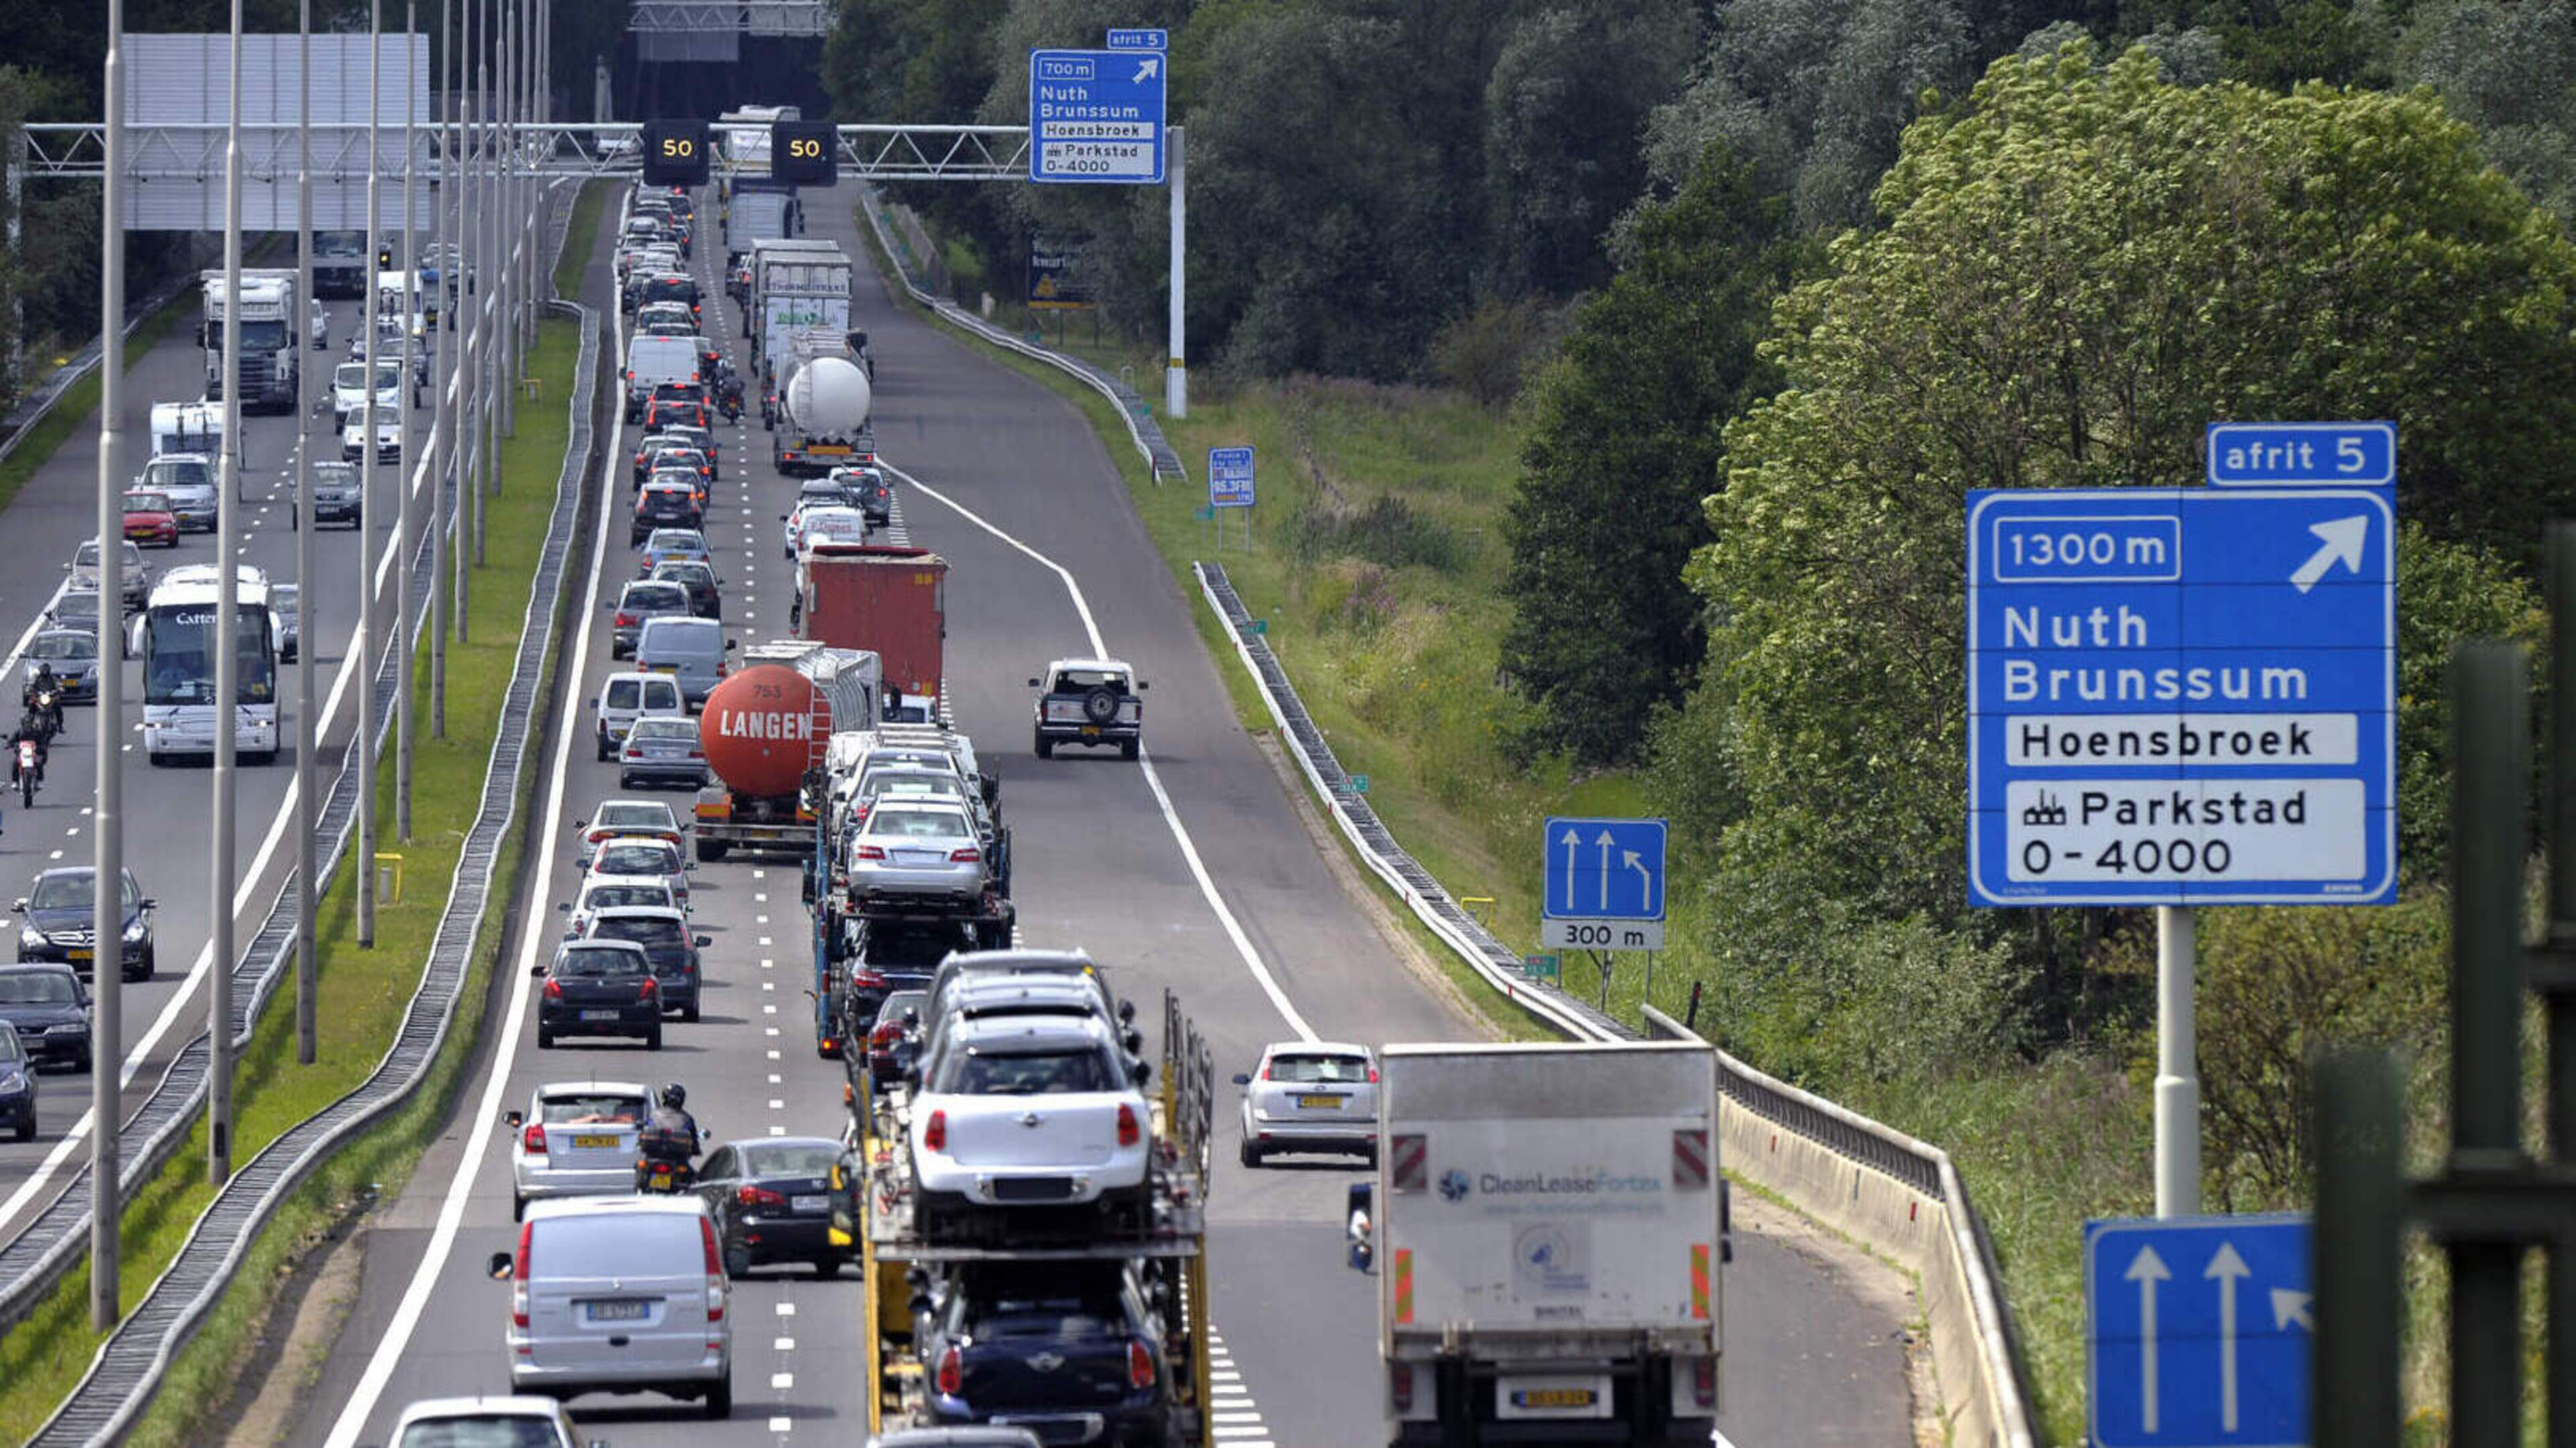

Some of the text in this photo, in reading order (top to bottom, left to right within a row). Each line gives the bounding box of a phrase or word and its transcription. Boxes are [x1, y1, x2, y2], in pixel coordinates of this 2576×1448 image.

[1112, 33, 1158, 46] afrit 5
[1044, 63, 1089, 74] 700 m
[1041, 85, 1087, 101] Nuth
[1041, 103, 1138, 118] Brunssum
[1046, 124, 1140, 136] Hoensbroek
[663, 139, 692, 156] 50
[790, 140, 820, 157] 50
[1065, 144, 1138, 157] Parkstad
[2226, 437, 2365, 471] afrit 5
[2010, 533, 2165, 565] 1300 m
[2004, 604, 2147, 649] Nuth
[2004, 659, 2307, 701] Brunssum
[753, 683, 782, 700] 753
[720, 710, 811, 739] LANGEN
[2023, 722, 2312, 758] Hoensbroek
[2082, 790, 2306, 826] Parkstad
[1565, 925, 1644, 946] 300 m
